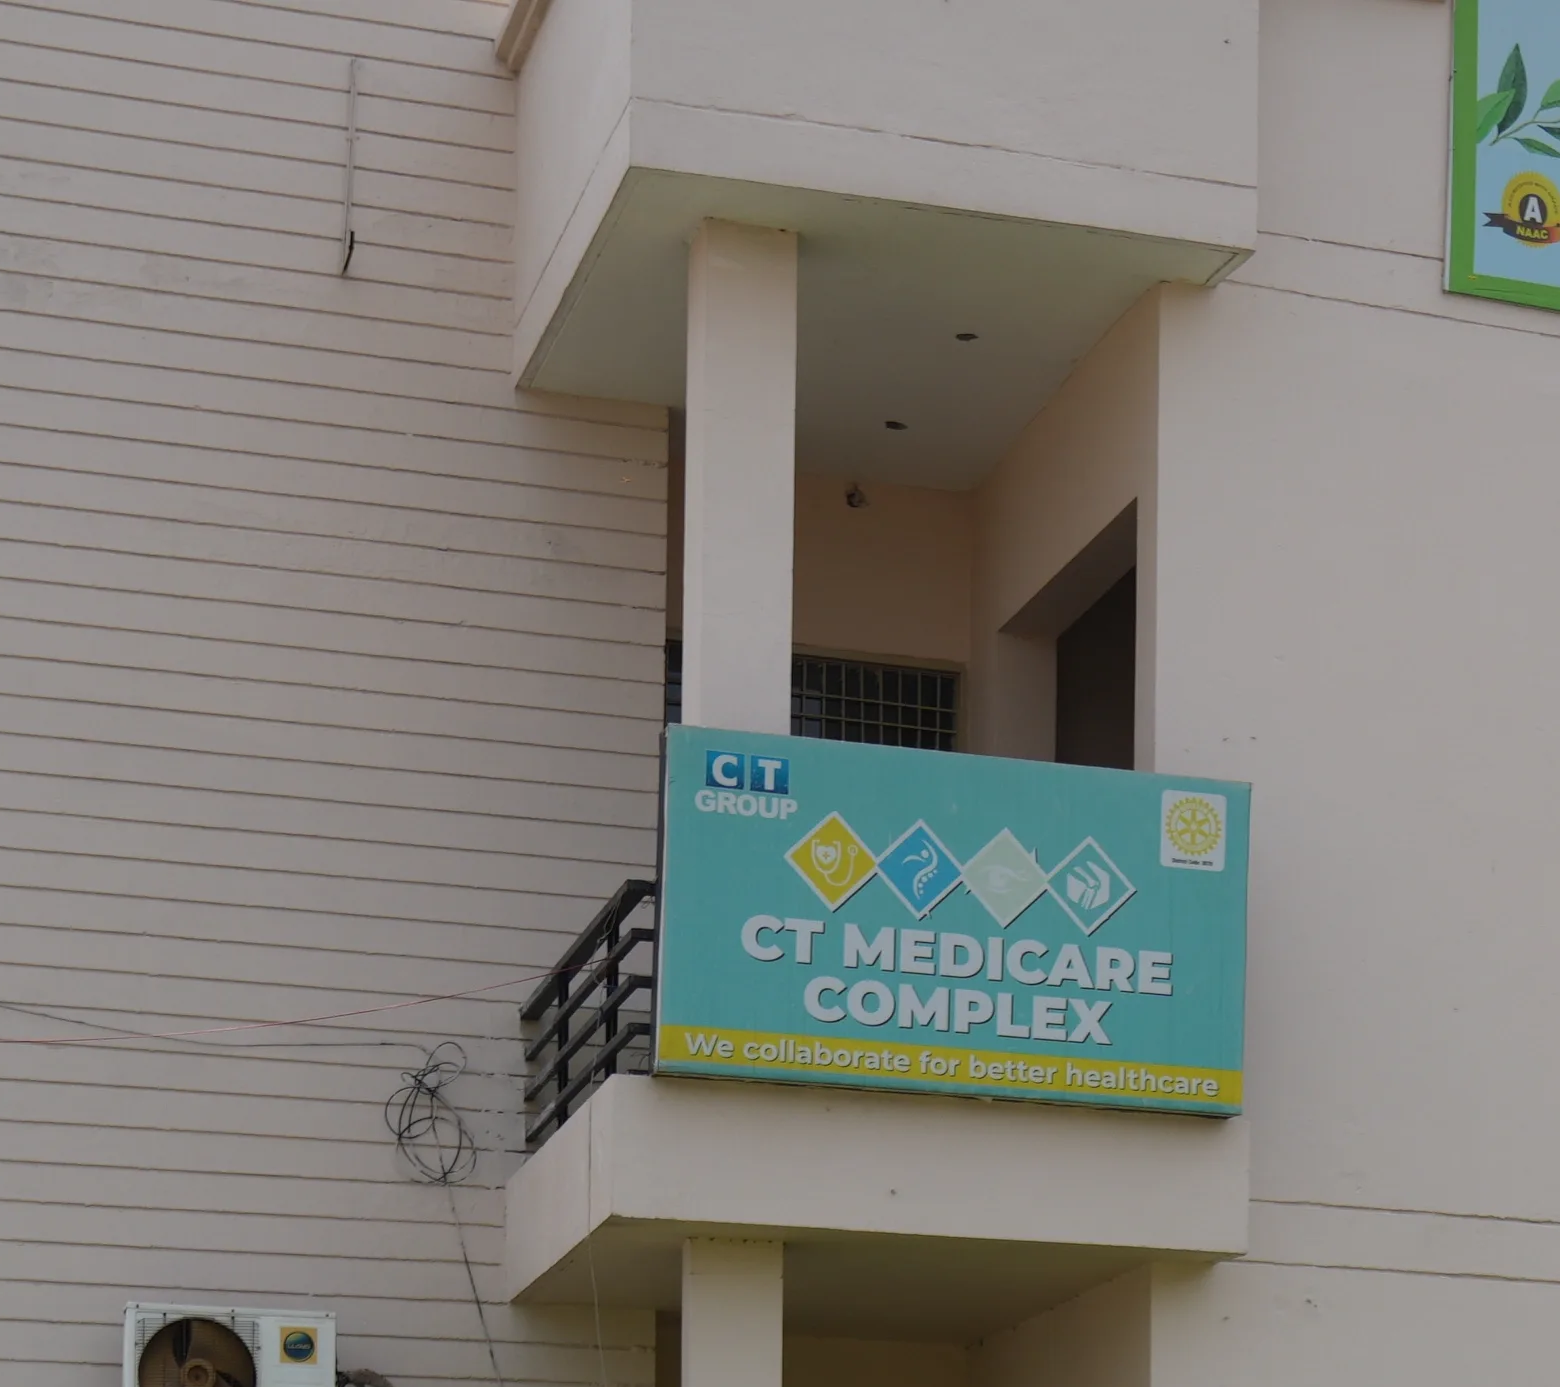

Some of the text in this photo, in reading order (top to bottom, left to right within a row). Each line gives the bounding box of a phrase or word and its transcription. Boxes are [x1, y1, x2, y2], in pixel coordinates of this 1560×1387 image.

[1523, 196, 1543, 223] A
[1515, 224, 1549, 239] NAAC
[711, 753, 783, 792] CT
[695, 790, 798, 820] GROUP
[741, 915, 1174, 997] CT MEDICARE
[803, 976, 1113, 1046] COMPLEX
[685, 1032, 1220, 1098] We collaborate for better healthcare
